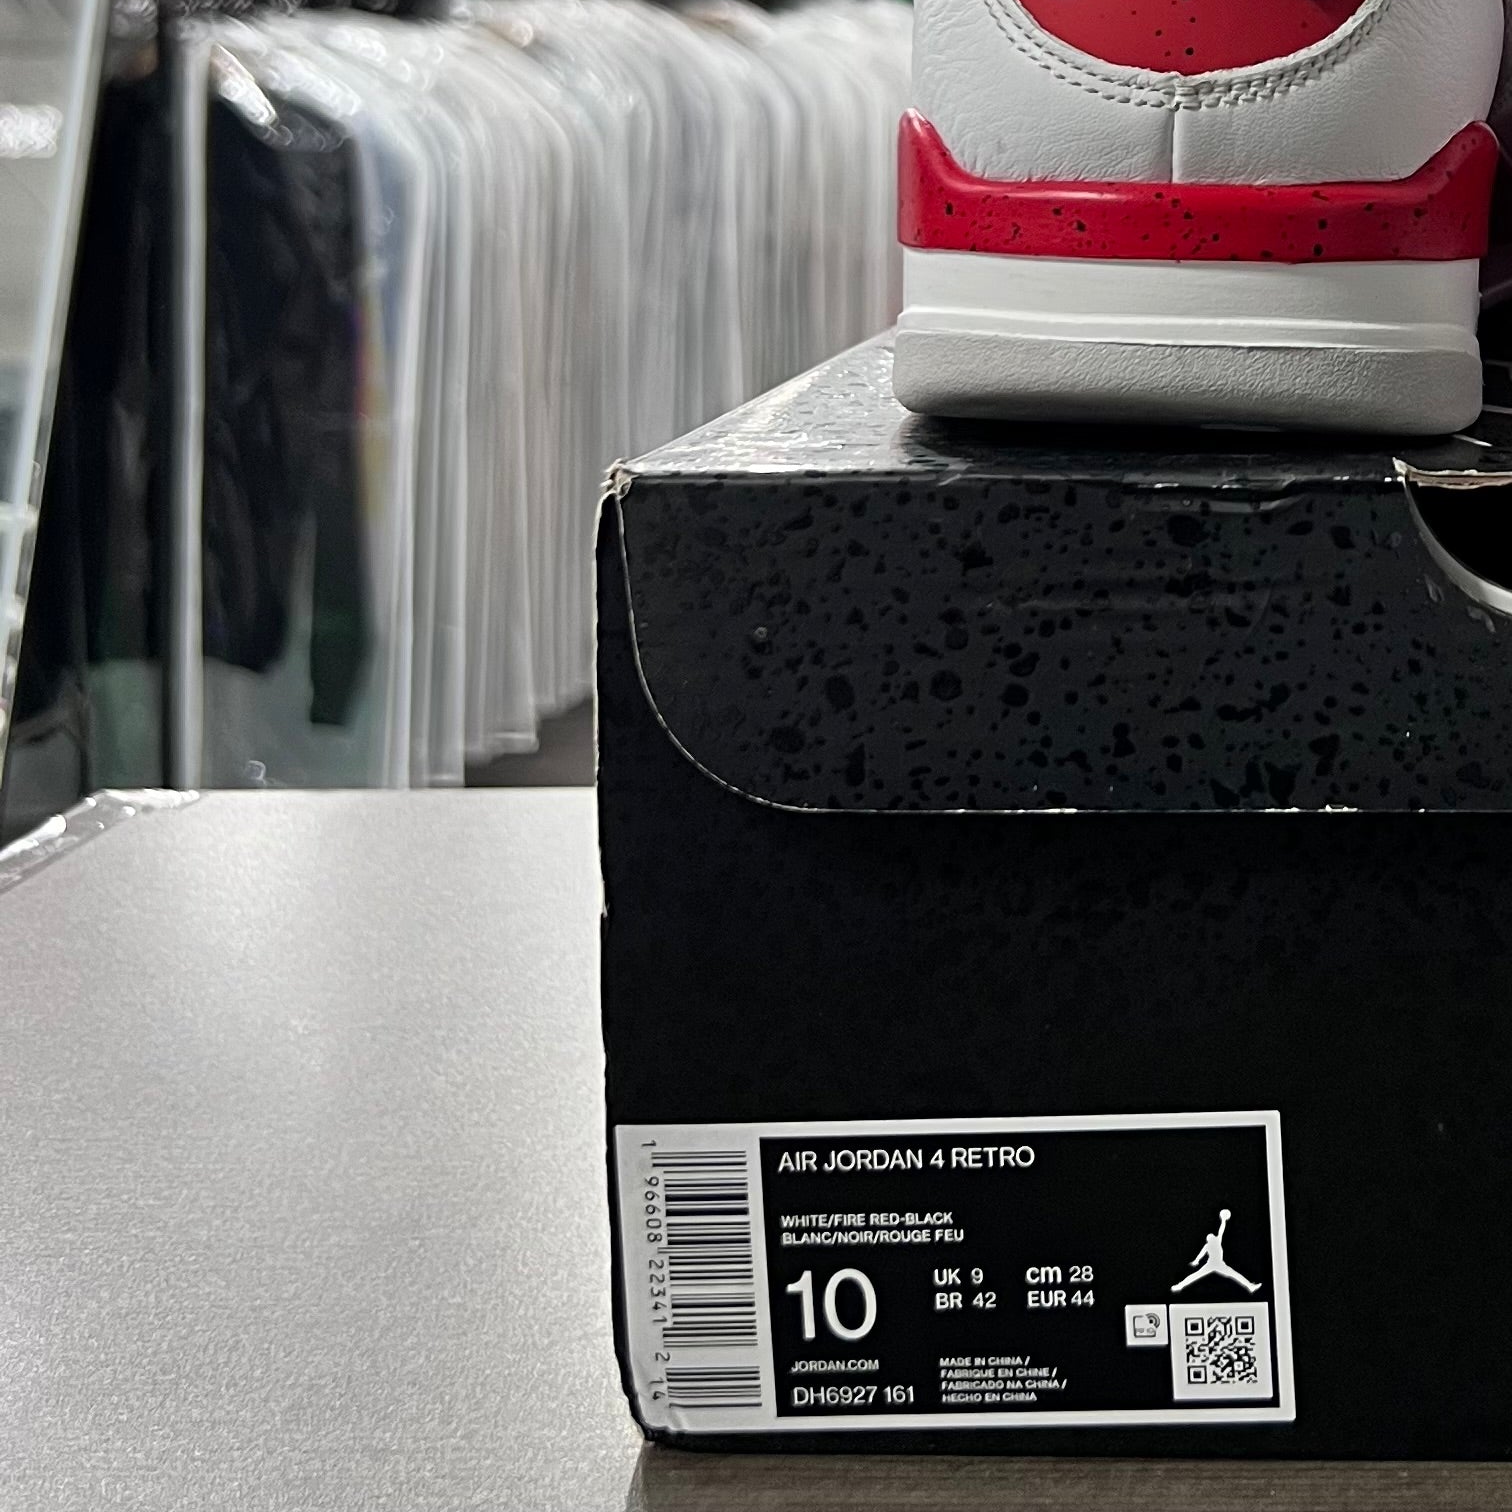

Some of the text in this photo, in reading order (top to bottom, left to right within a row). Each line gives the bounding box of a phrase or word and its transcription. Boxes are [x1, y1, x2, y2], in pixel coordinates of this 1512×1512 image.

[778, 1146, 1035, 1172] AIR JORDAN 4 RETRO
[644, 1176, 663, 1243] 96608
[781, 1212, 954, 1228] WHITE/FIRE RED-BLACK
[782, 1229, 965, 1245] BLANC/NOIR/ROUGE FEU
[934, 1268, 984, 1285] UK 9
[1026, 1266, 1094, 1284] cm 28
[648, 1259, 668, 1325] 22341
[1027, 1290, 1096, 1308] EUR 44
[786, 1268, 877, 1340] 10
[935, 1292, 997, 1310] BR 42
[791, 1359, 880, 1373] JORDAN.COM
[940, 1357, 971, 1367] MADE
[974, 1357, 985, 1366] IN
[988, 1356, 1023, 1365] CHINA
[940, 1368, 995, 1378] FABRIQUE
[998, 1368, 1013, 1377] EN
[1016, 1367, 1049, 1377] CHINE
[942, 1380, 1004, 1390] FABRICADO
[1007, 1380, 1023, 1389] NA
[1025, 1379, 1060, 1388] CHINA
[793, 1385, 915, 1406] DH6927 161
[942, 1392, 1037, 1403] HECHO EN CHINA
